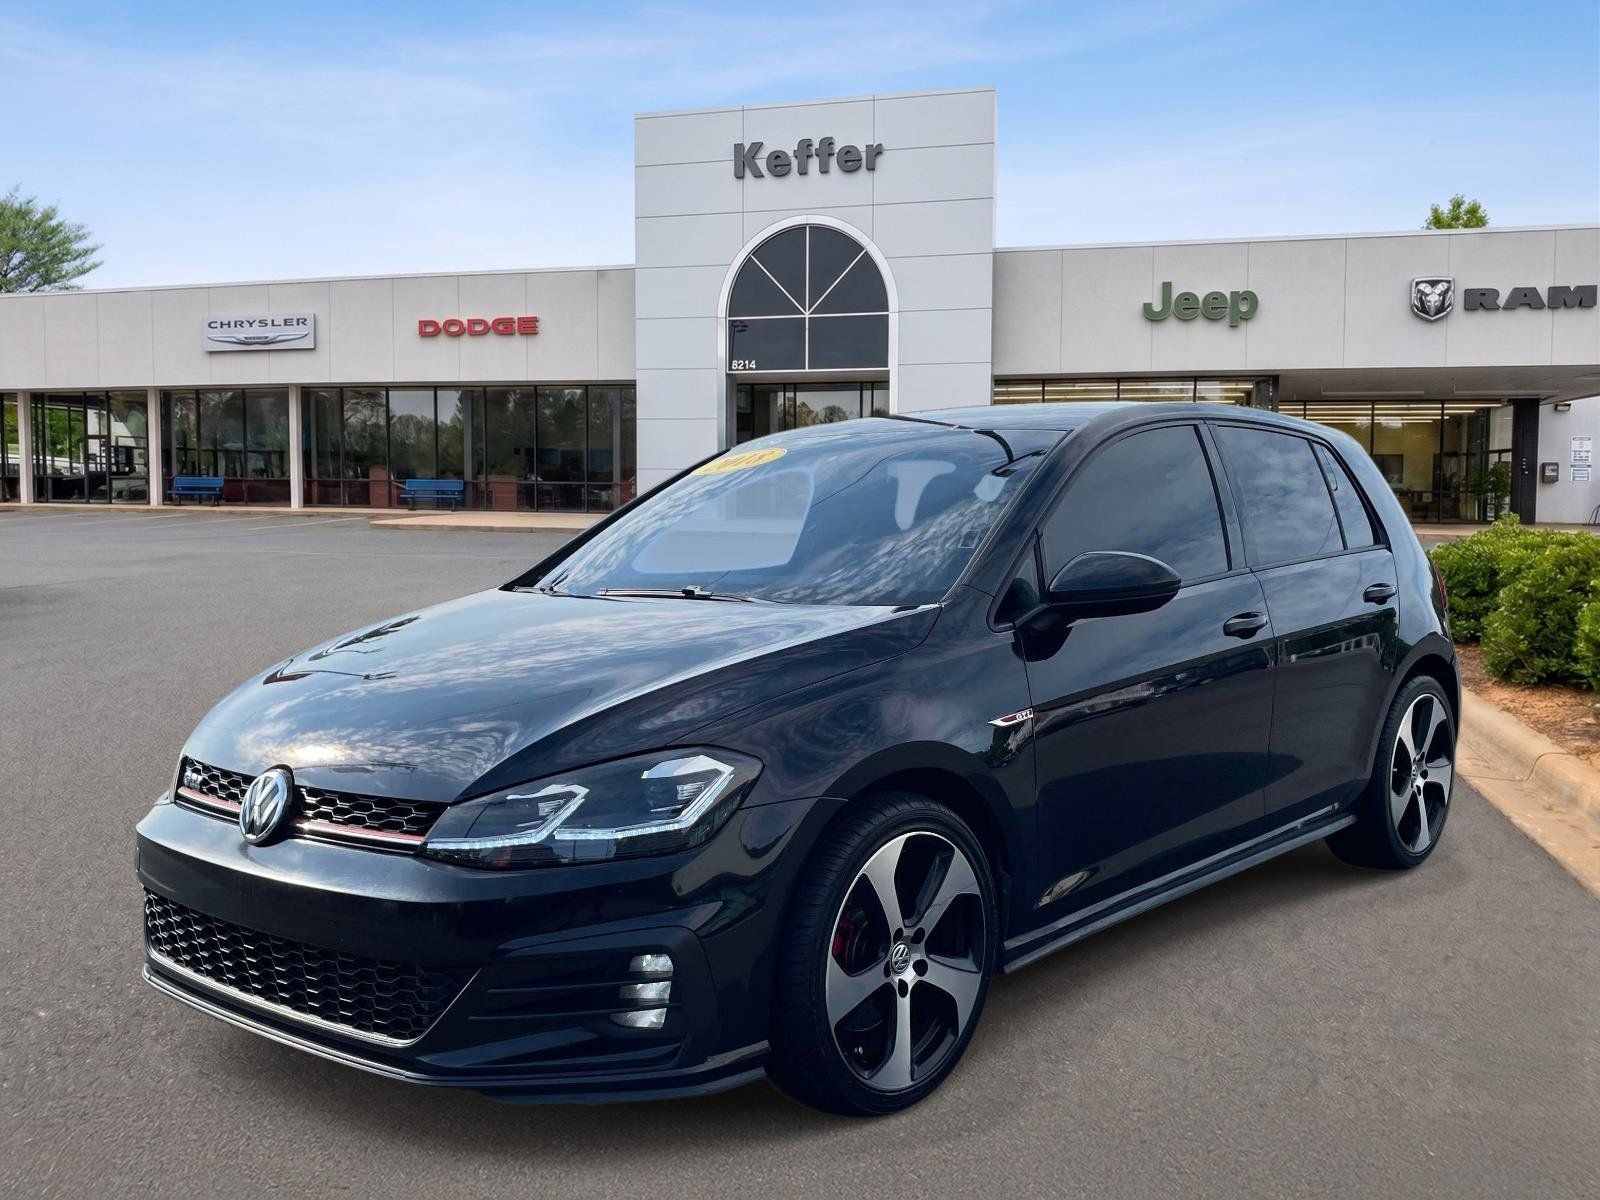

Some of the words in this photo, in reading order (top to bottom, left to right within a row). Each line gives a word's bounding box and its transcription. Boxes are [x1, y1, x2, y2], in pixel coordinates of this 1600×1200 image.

[733, 136, 883, 179] Keffer
[1142, 281, 1259, 328] Jeep
[1464, 285, 1598, 311] RAM
[207, 317, 308, 330] CHRYSLER
[418, 316, 540, 337] DODGE
[731, 359, 757, 370] 8214
